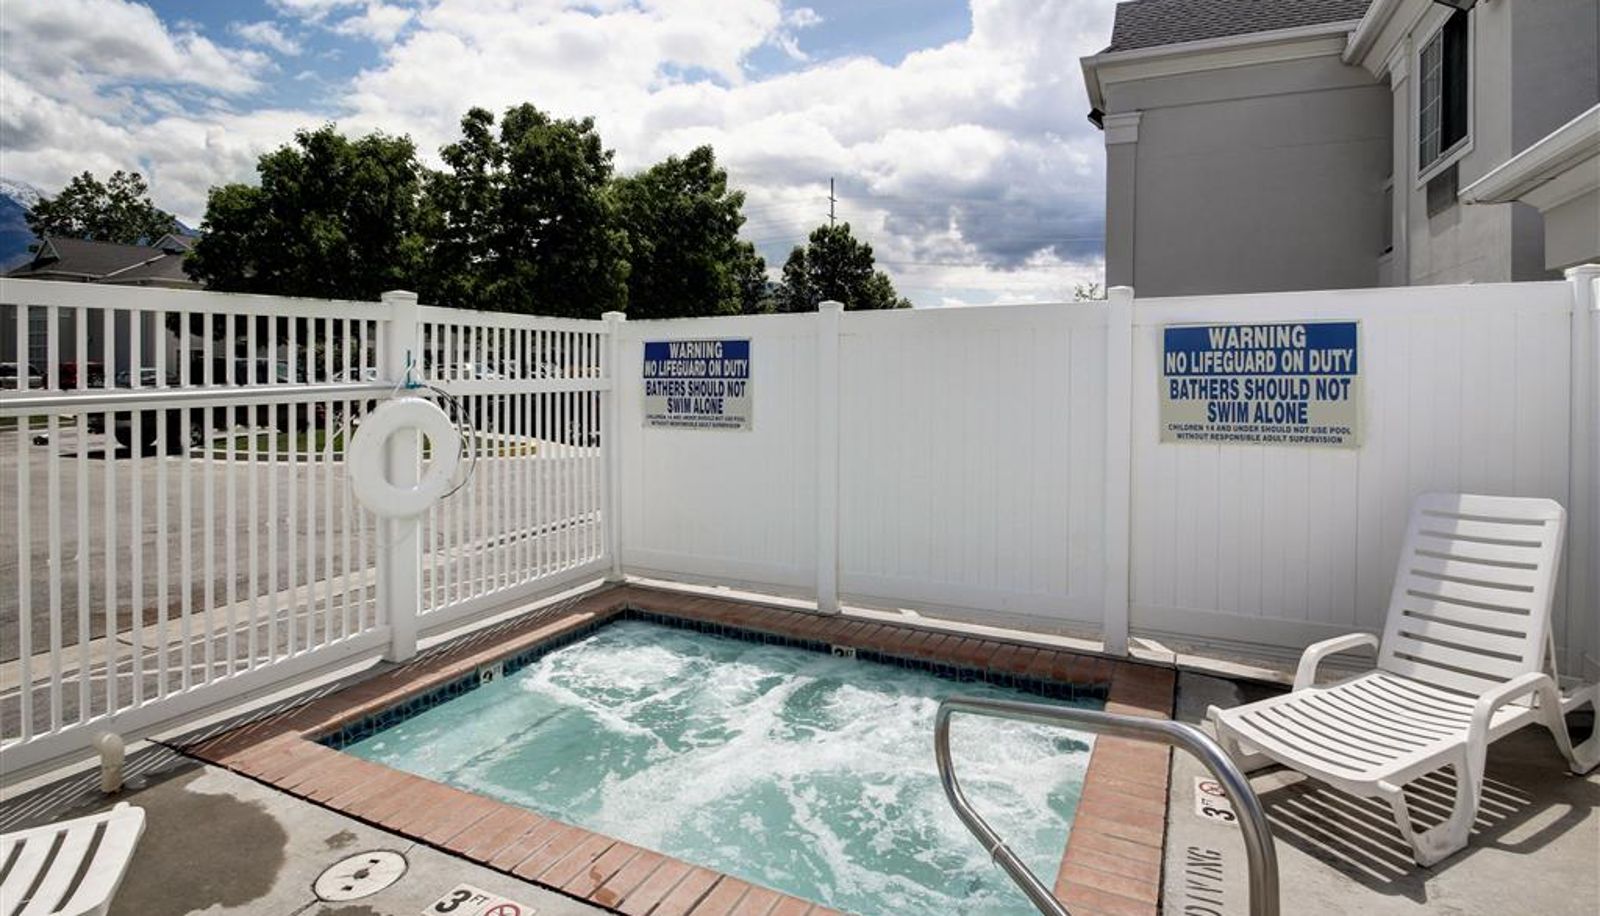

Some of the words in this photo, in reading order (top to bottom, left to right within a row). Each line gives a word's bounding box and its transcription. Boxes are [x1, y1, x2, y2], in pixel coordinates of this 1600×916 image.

[1209, 325, 1306, 348] WARNING
[669, 341, 723, 358] WARNING
[644, 360, 657, 376] NO
[659, 360, 706, 376] LIFEGUARD
[708, 360, 722, 376] ON
[724, 360, 748, 376] DUTY
[1166, 351, 1186, 373] NO
[1192, 350, 1276, 373] LIFEGUARD
[1281, 350, 1304, 373] ON
[1309, 349, 1353, 373] DUTY
[646, 381, 685, 396] BATHERS
[688, 381, 725, 397] SHOULD
[727, 381, 746, 397] NOT
[1170, 378, 1239, 400] BATHERS
[1244, 378, 1310, 401] SHOULD
[1316, 378, 1351, 401] NOT
[667, 398, 691, 413] SWIM
[693, 398, 724, 414] ALONE
[1207, 402, 1249, 423] SWIM
[1254, 402, 1308, 424] ALONE
[1202, 806, 1235, 821] 3
[434, 889, 473, 914] 3
[469, 893, 490, 906] FT
